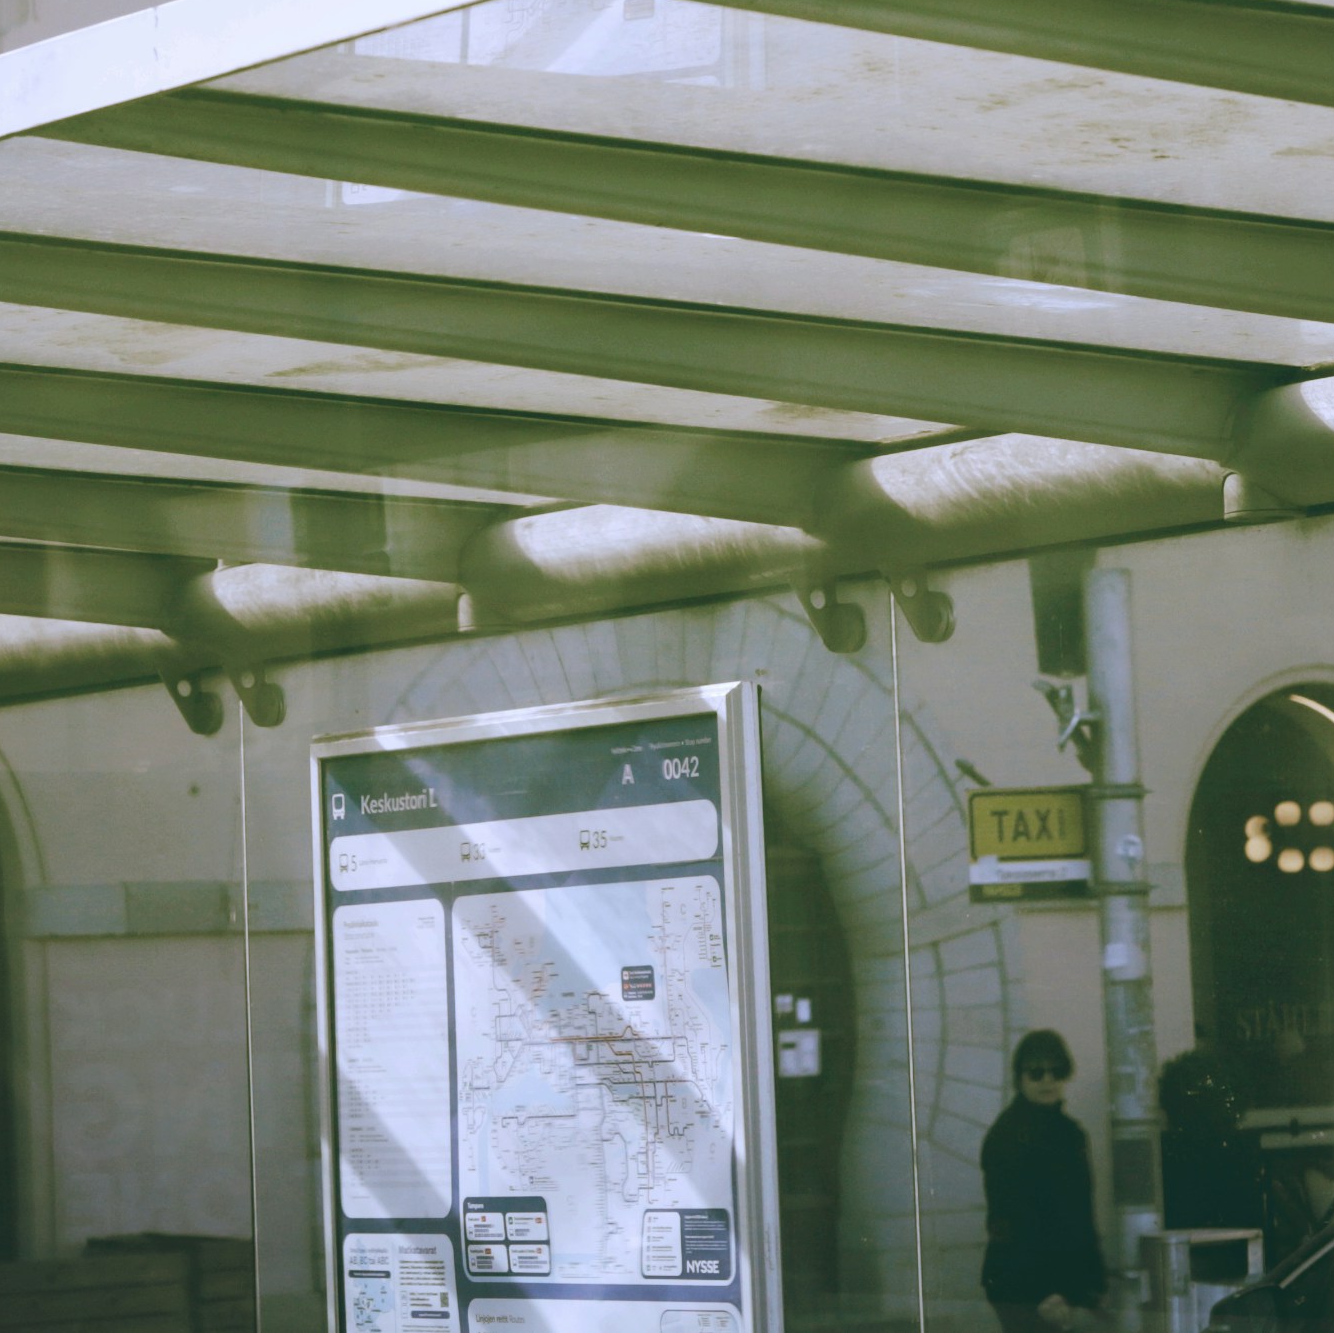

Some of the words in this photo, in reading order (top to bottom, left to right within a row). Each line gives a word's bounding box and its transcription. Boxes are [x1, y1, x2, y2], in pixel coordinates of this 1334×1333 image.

[621, 763, 635, 785] A
[663, 756, 700, 780] 0042
[361, 789, 427, 815] Keskustori
[429, 788, 438, 808] L
[990, 808, 1066, 843] TAXI
[592, 830, 608, 849] 35
[686, 1260, 720, 1274] NYSSE
